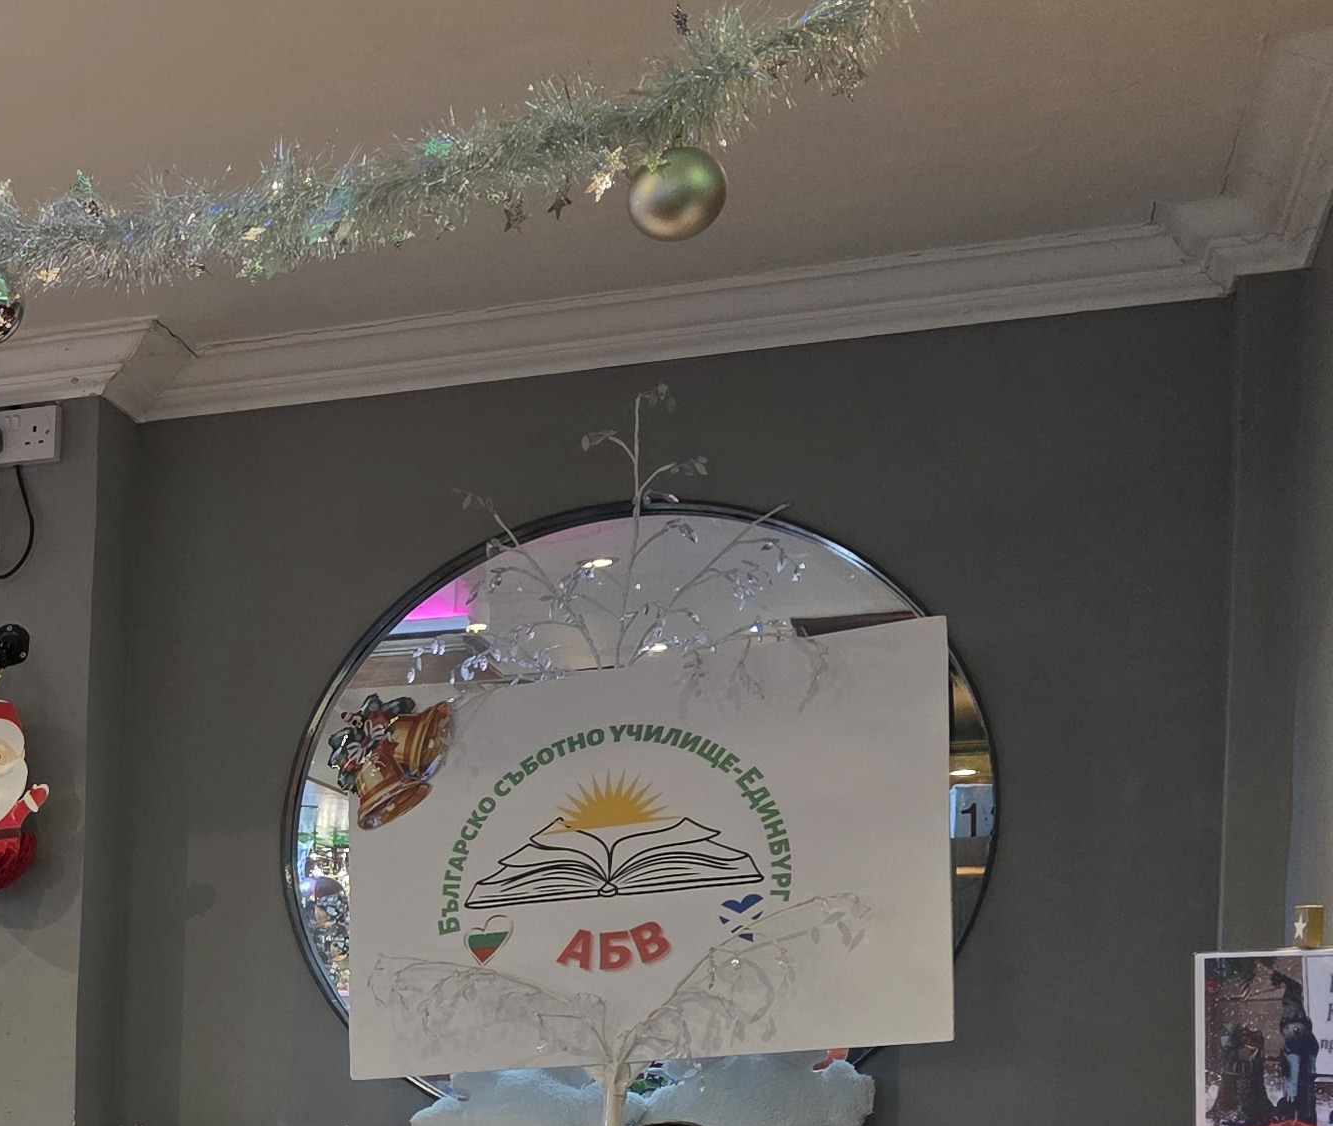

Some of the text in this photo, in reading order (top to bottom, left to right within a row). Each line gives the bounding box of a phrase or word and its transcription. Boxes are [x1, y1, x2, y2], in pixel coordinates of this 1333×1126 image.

[437, 796, 497, 936] БЪЛГАРСКО
[493, 728, 606, 797] СЪБОТНО
[555, 920, 673, 972] АБВ
